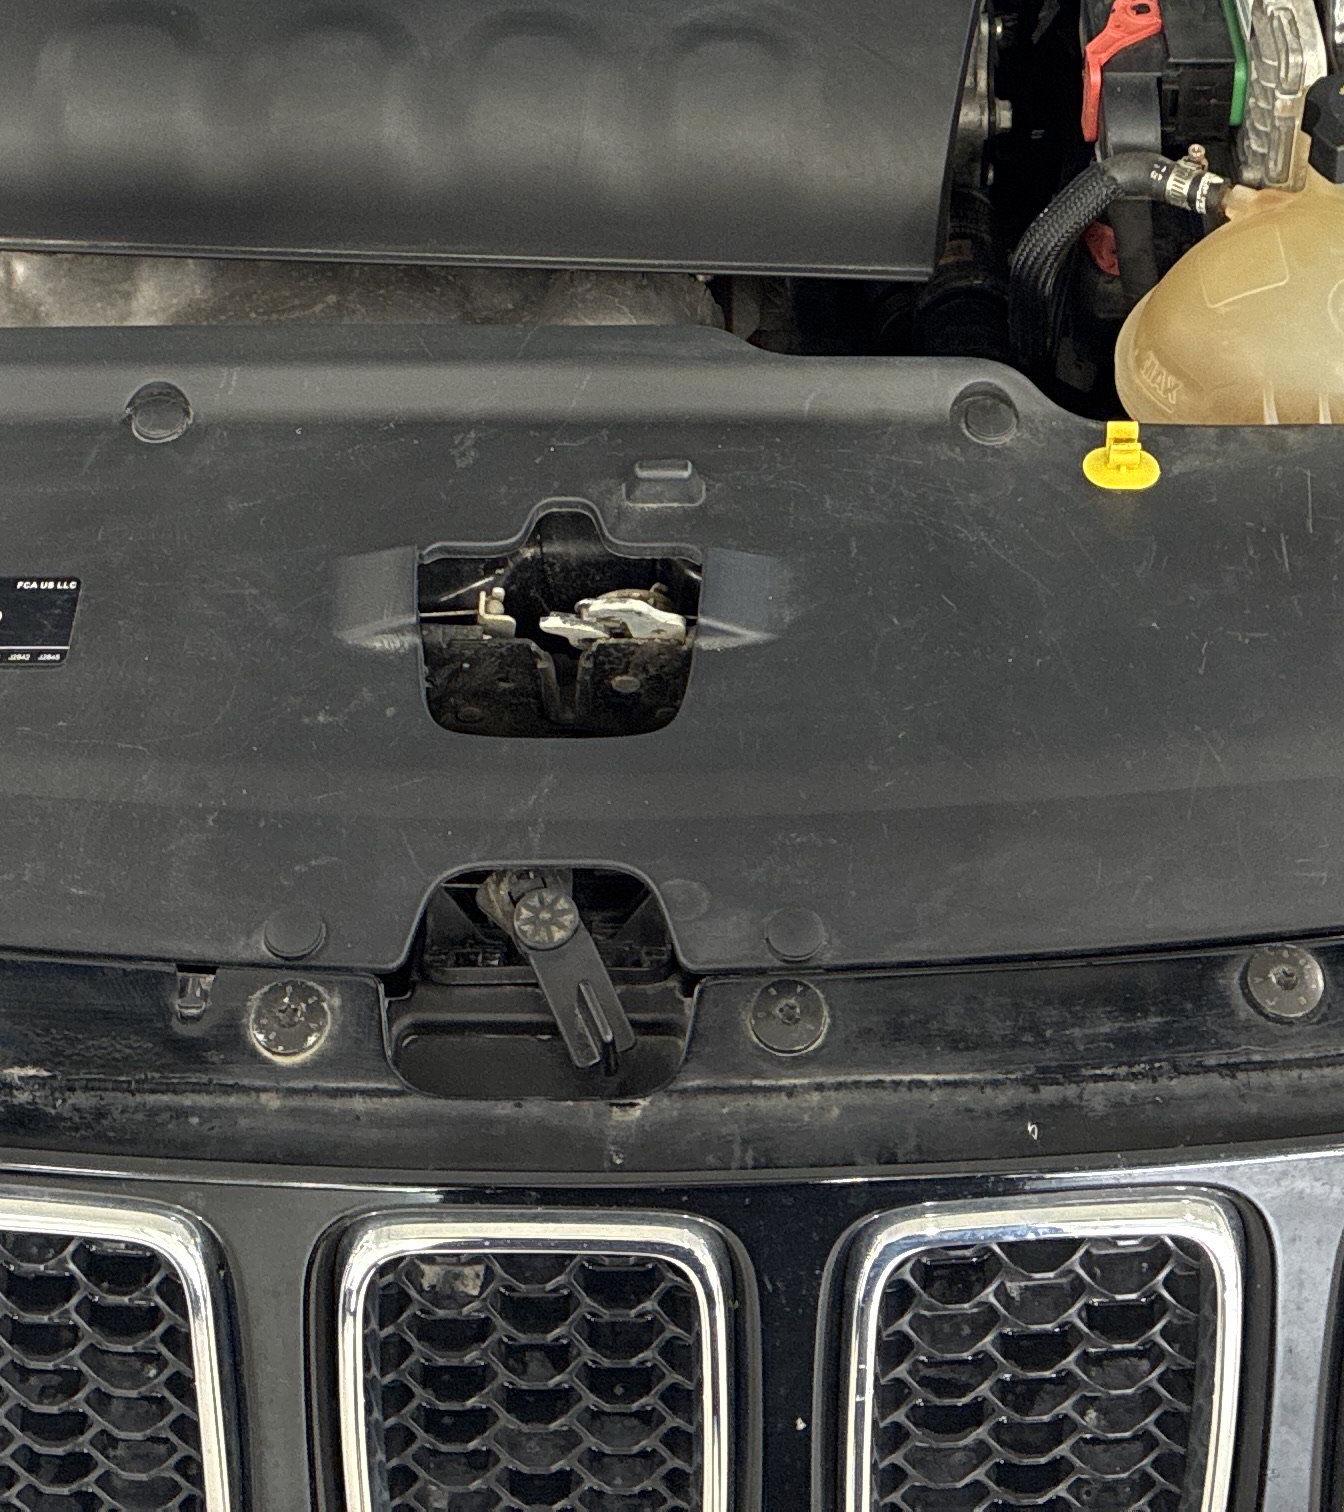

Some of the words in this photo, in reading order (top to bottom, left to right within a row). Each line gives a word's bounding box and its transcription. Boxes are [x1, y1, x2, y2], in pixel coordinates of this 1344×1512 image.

[16, 580, 38, 590] FCA
[40, 580, 54, 590] US
[56, 580, 78, 590] LLC
